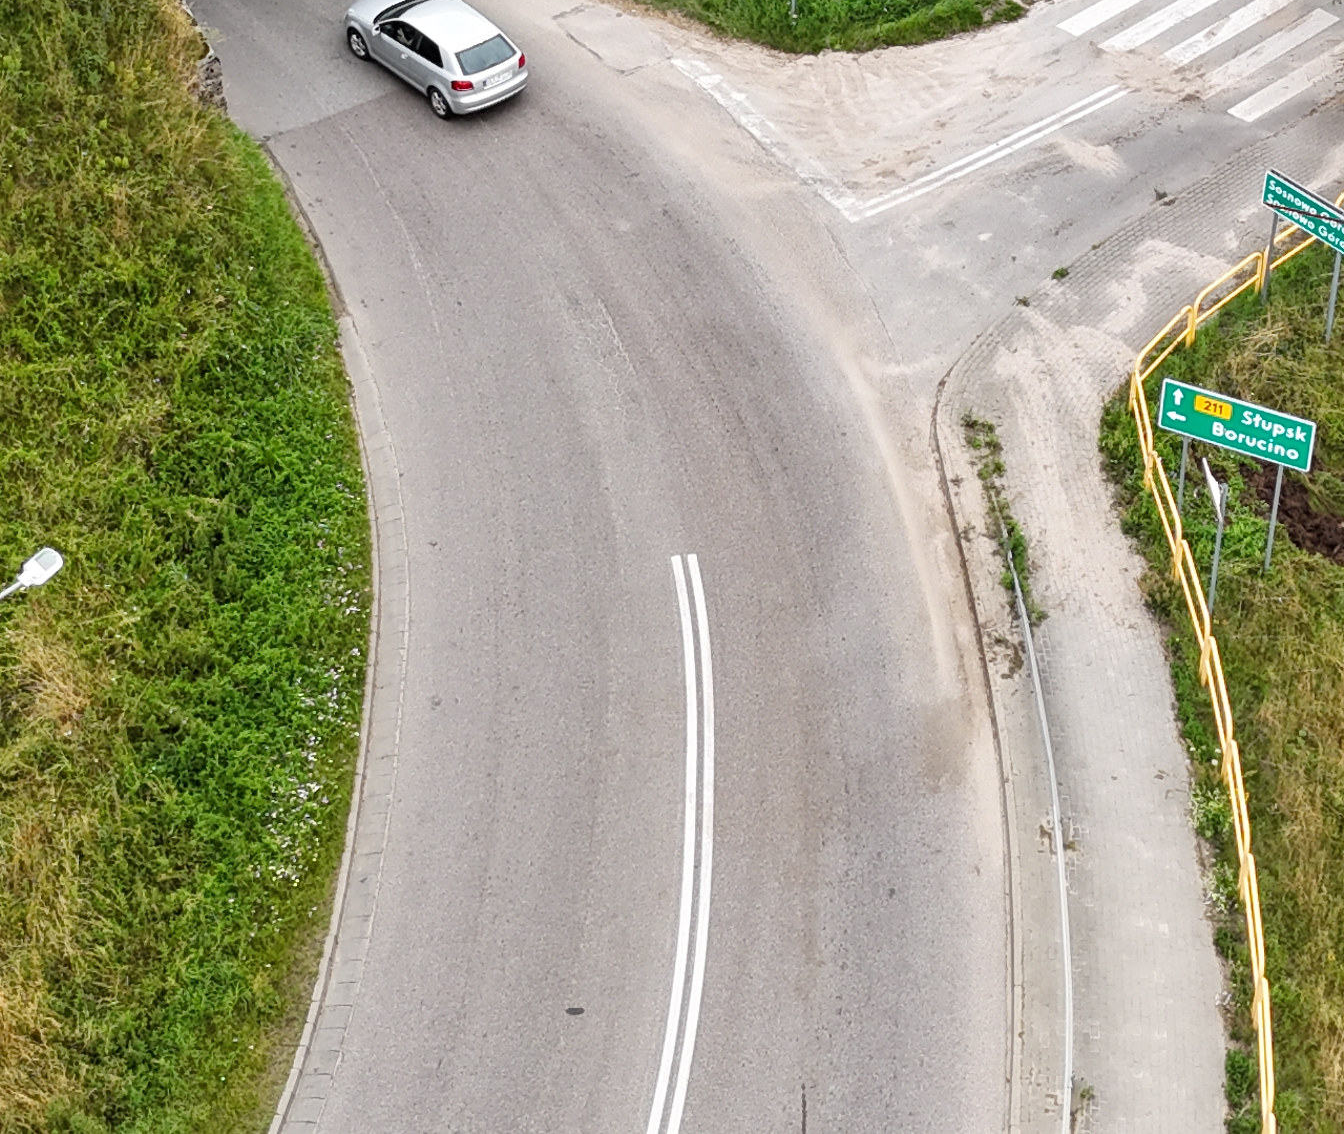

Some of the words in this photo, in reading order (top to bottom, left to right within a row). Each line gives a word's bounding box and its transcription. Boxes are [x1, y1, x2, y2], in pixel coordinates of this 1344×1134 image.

[1203, 400, 1224, 416] 211
[1211, 421, 1300, 461] Borucino
[1241, 410, 1307, 443] Słupsk
